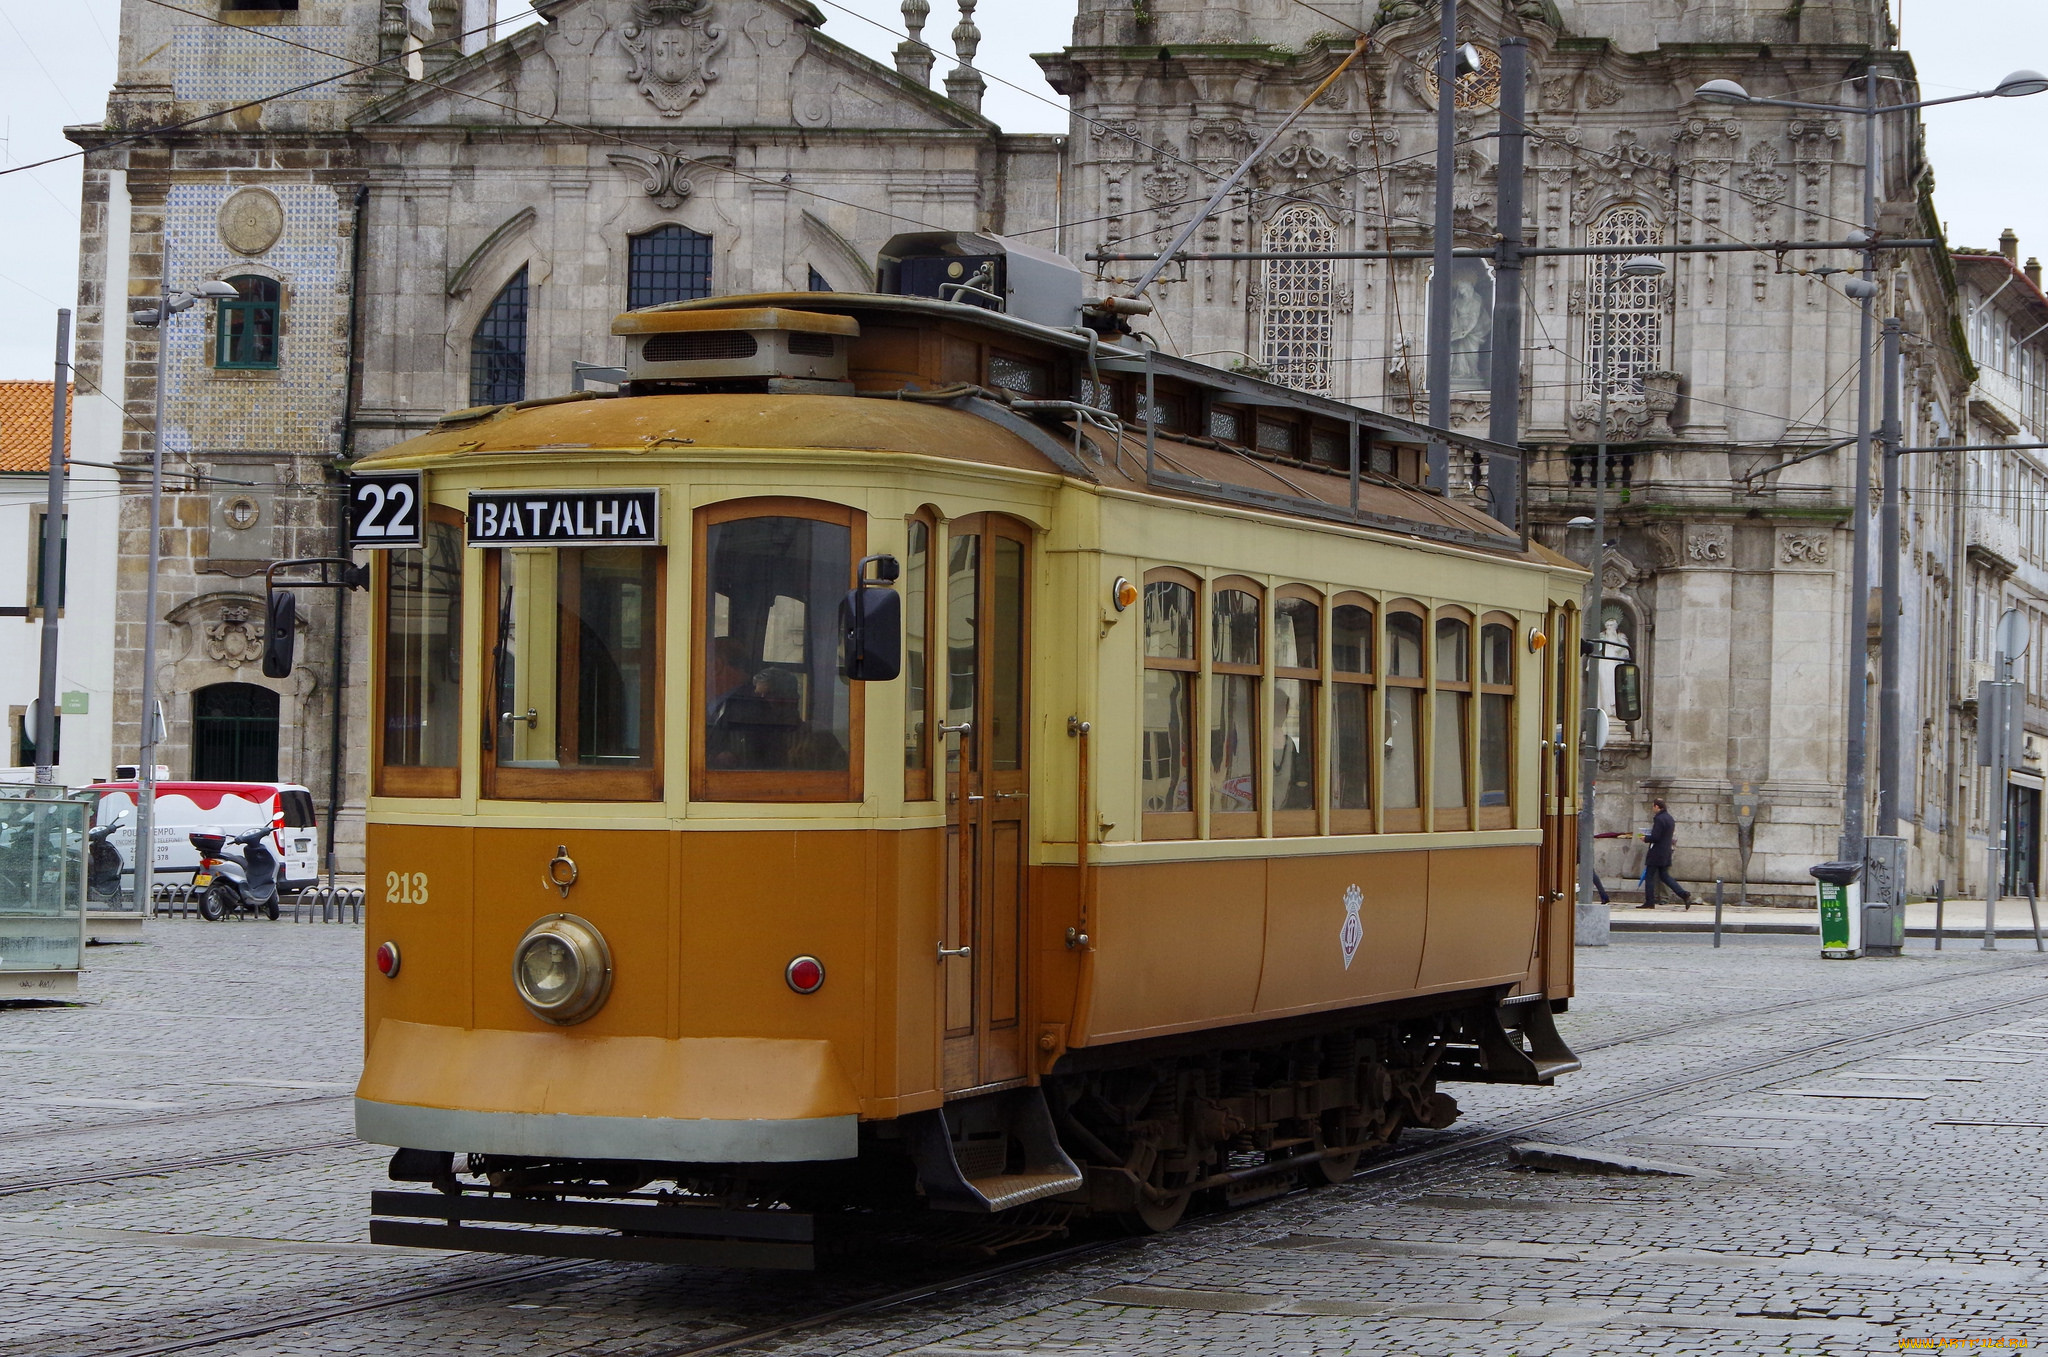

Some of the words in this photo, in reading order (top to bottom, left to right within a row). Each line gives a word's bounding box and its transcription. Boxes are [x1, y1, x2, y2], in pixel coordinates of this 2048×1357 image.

[356, 483, 415, 537] 22
[476, 500, 647, 538] BATALHA
[153, 827, 176, 836] EMPO.
[386, 870, 429, 905] 213
